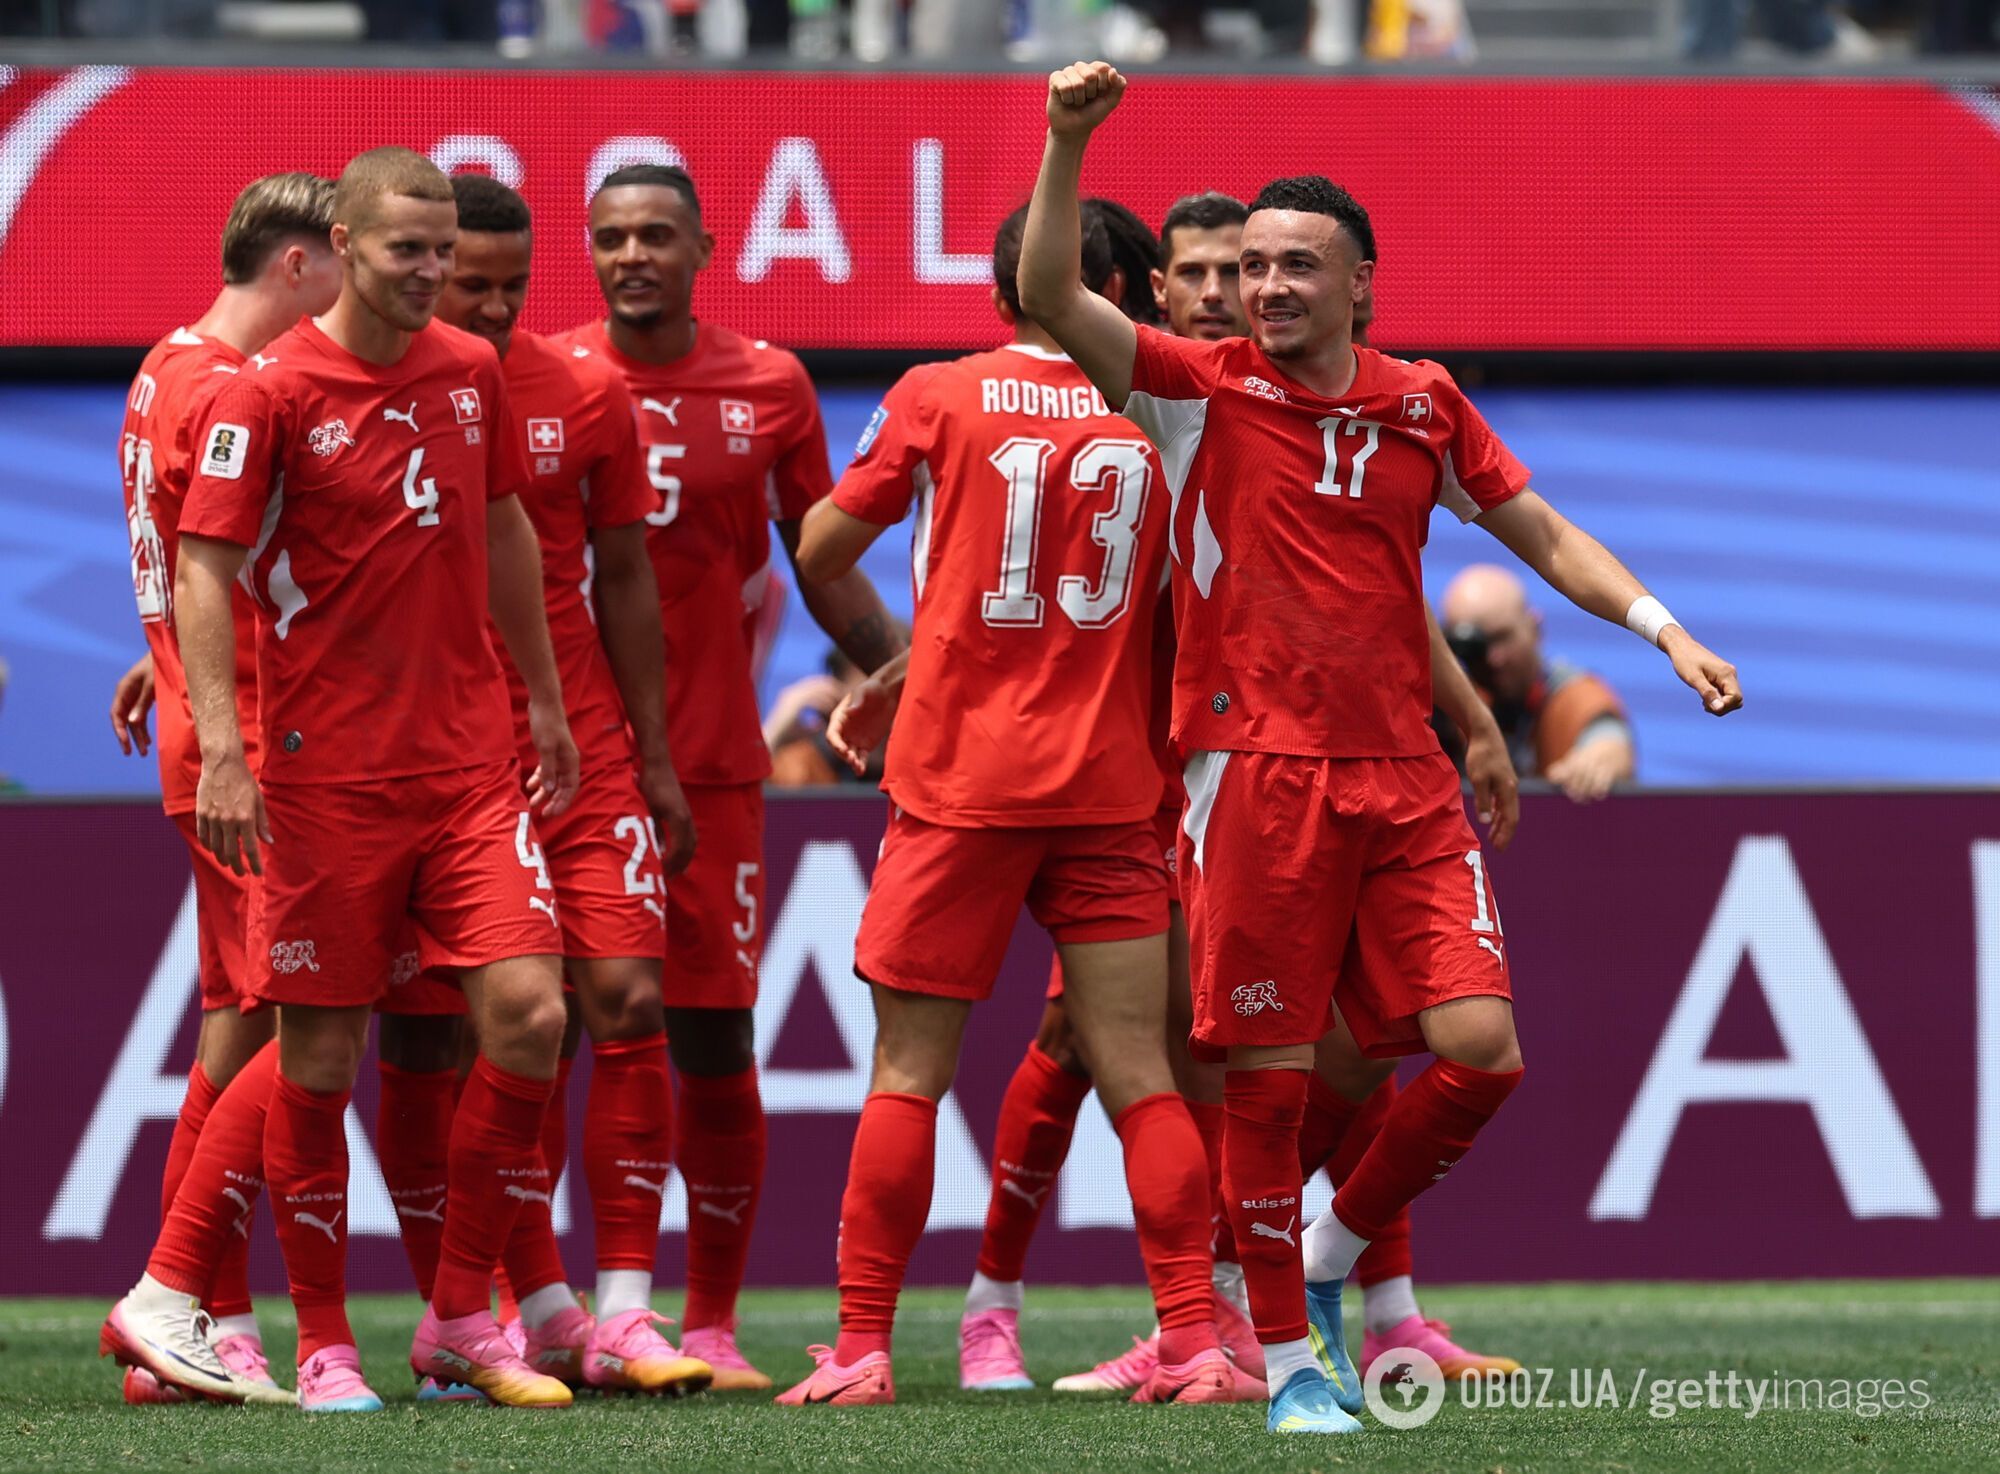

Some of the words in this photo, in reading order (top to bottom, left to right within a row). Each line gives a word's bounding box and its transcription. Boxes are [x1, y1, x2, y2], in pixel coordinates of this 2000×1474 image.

[402, 447, 440, 527] 4
[645, 443, 686, 526] 5
[1315, 416, 1382, 498] 17
[982, 437, 1152, 629] 13
[515, 811, 552, 889] 4
[732, 862, 759, 942] 5
[1464, 849, 1504, 937] 1
[1242, 1197, 1296, 1209] suisse
